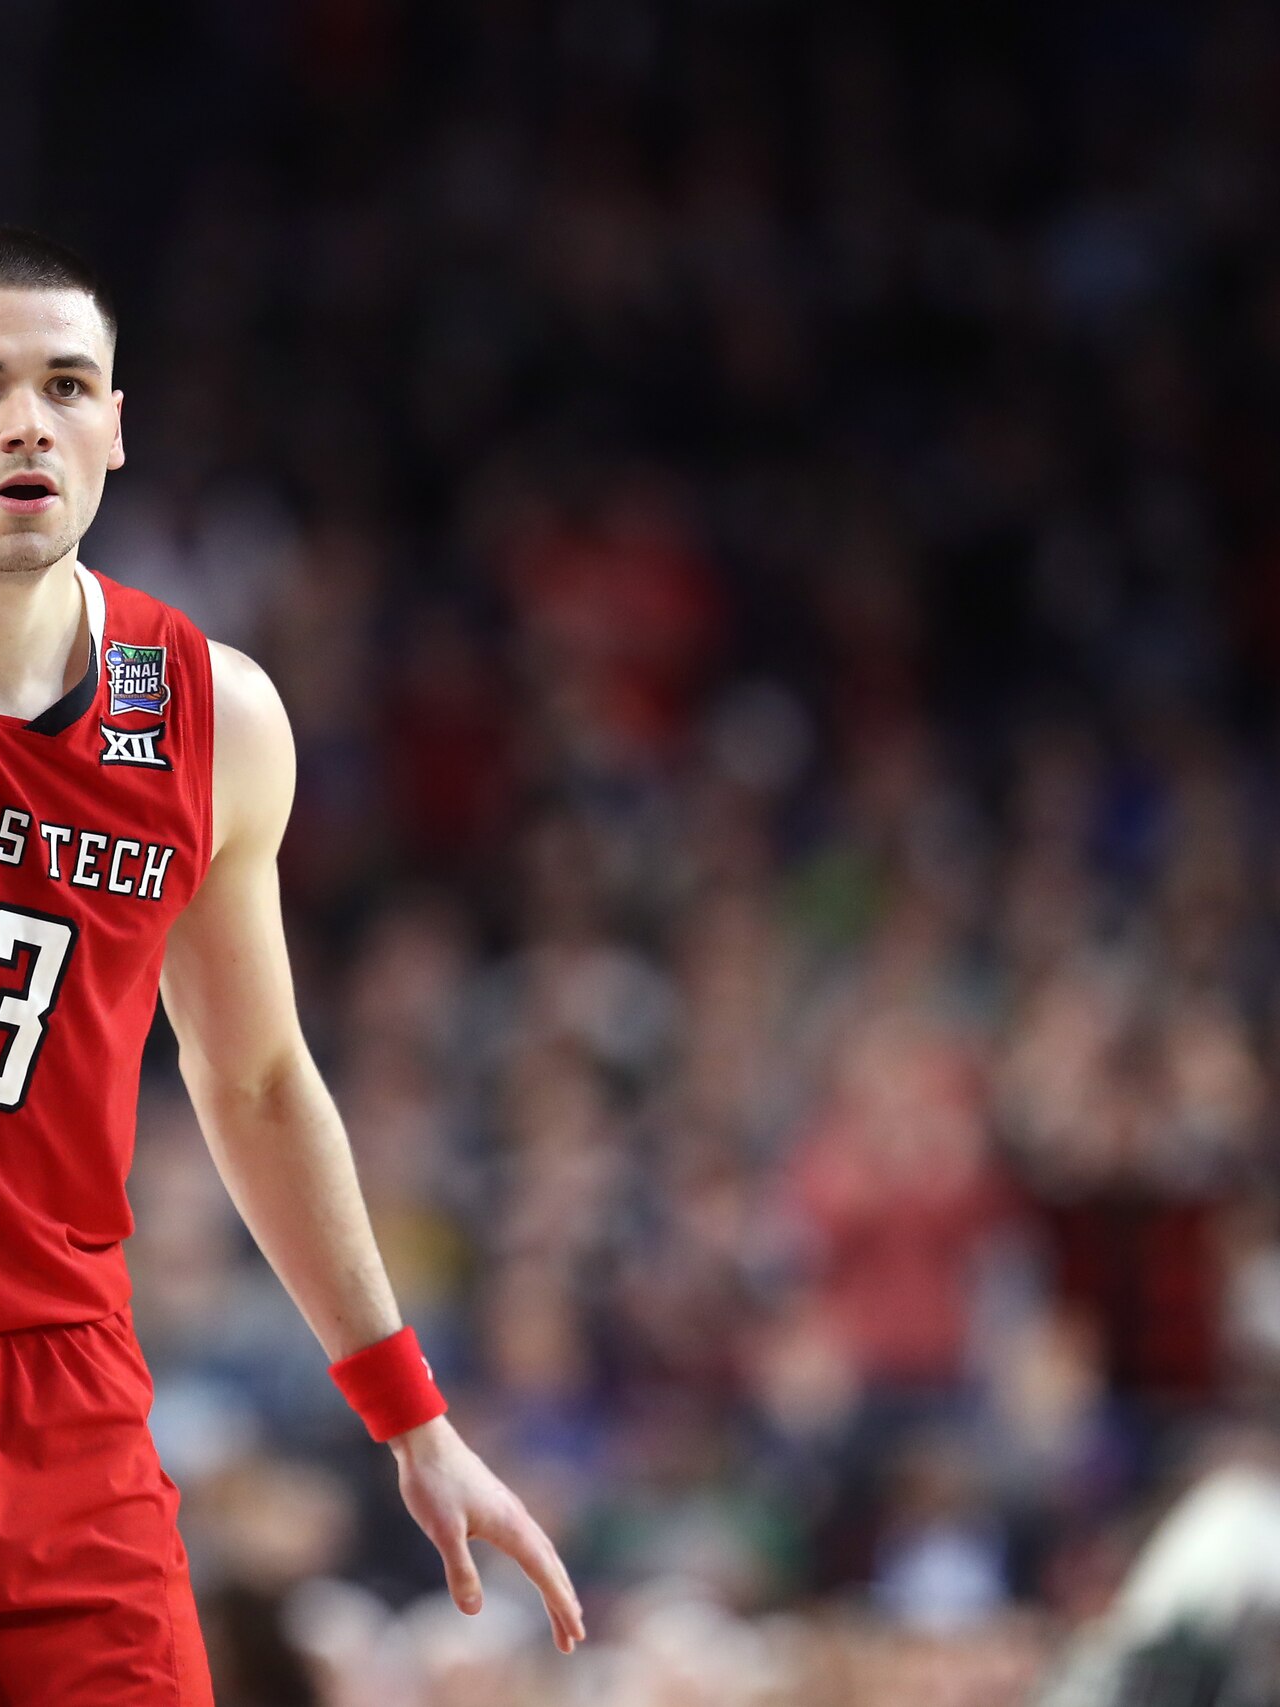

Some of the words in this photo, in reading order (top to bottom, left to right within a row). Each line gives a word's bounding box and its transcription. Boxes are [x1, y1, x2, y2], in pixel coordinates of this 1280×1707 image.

[114, 663, 160, 679] FINAL
[114, 678, 158, 694] FOUR
[100, 724, 167, 766] XII
[39, 822, 175, 899] TECH
